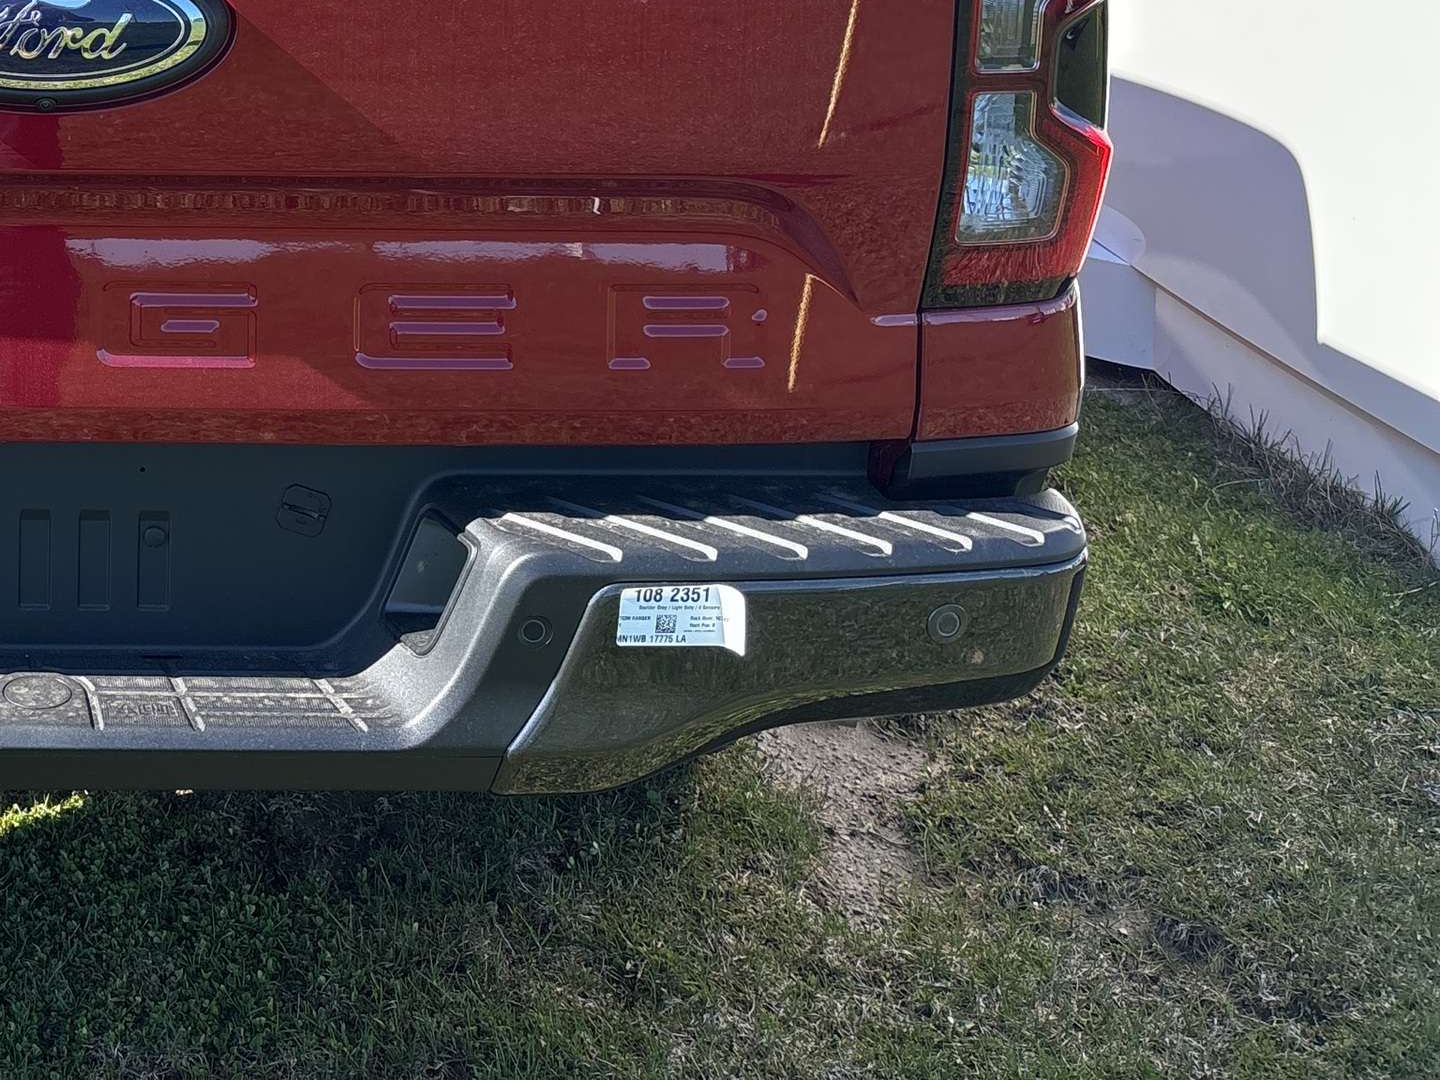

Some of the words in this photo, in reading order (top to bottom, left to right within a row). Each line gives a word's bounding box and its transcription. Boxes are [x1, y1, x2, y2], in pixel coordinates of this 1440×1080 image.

[635, 589, 664, 603] 108
[670, 587, 710, 603] 2351
[675, 634, 687, 643] LA
